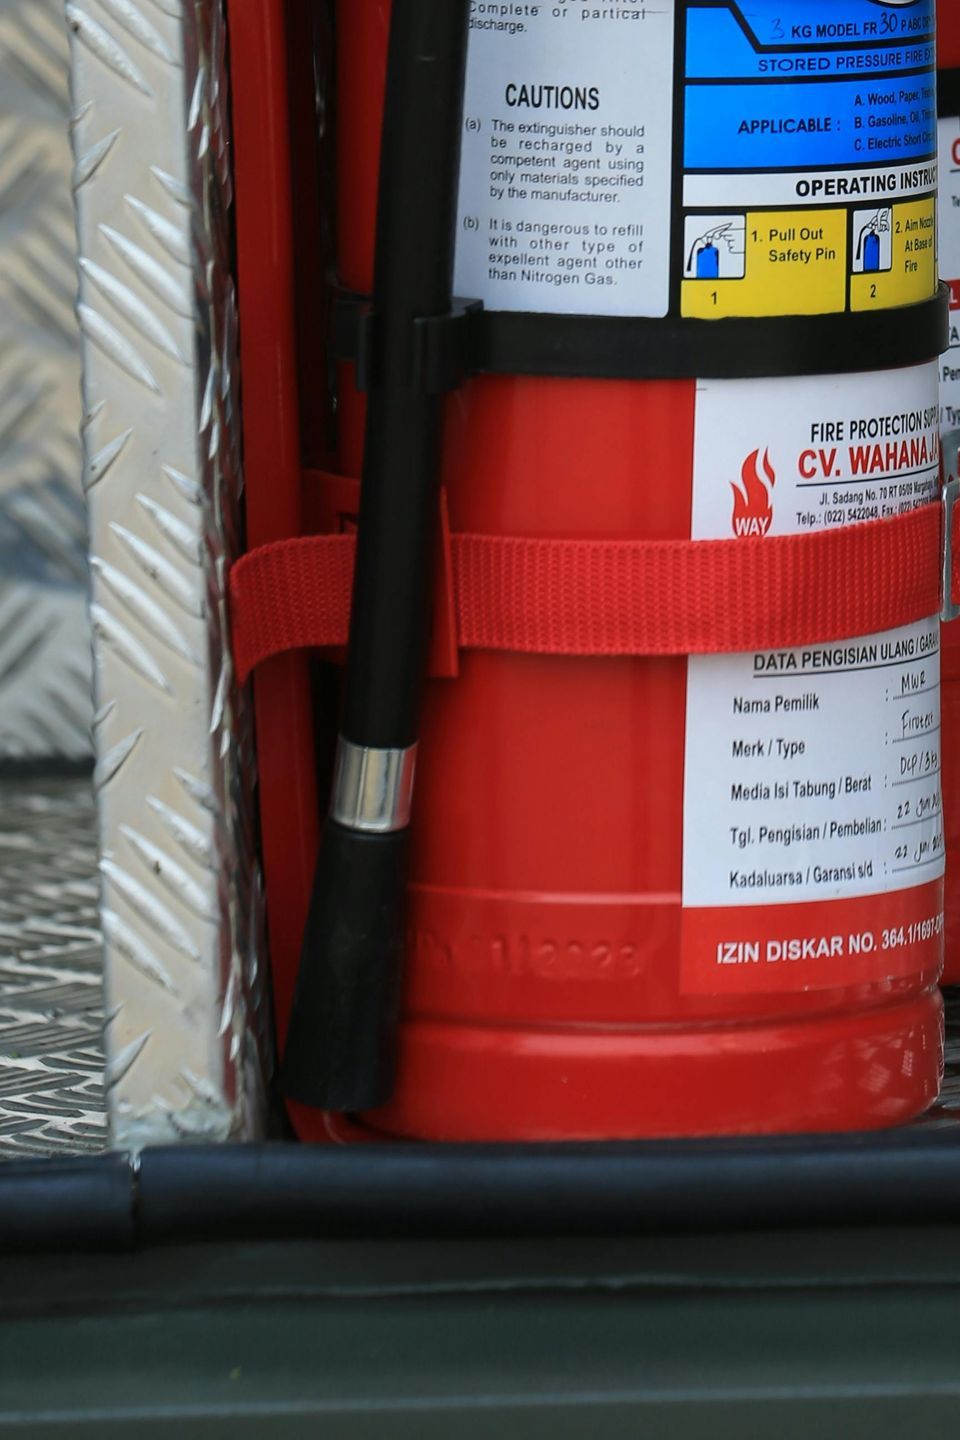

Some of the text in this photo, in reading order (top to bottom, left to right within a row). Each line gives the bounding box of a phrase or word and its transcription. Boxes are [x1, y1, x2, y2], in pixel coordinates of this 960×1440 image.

[552, 7, 568, 18] or
[581, 8, 646, 21] partical
[791, 24, 812, 39] KG
[815, 22, 860, 38] MODEL
[863, 21, 878, 35] FR
[758, 49, 923, 72] STORED PRESSURE FIRE
[505, 83, 600, 110] CAUTIONS
[854, 94, 866, 106] A.
[867, 92, 897, 106] Wood,
[465, 117, 645, 137] (a) The extinguisher should
[737, 117, 832, 134] APPLICABLE
[854, 116, 866, 129] B.
[867, 113, 909, 128] Gasoline,
[490, 136, 645, 156] be recharged by a
[854, 138, 866, 151] C.
[867, 136, 902, 150] Electric
[490, 154, 645, 173] competent agent using
[490, 170, 644, 188] only materials specified
[796, 173, 897, 198] OPERATING
[490, 185, 621, 203] by the manufacturer.
[462, 215, 644, 236] (b) It is dangerous to refill
[751, 227, 823, 243] 1. Pull Out
[895, 221, 903, 234] 2.
[904, 218, 919, 233] Aim
[488, 235, 645, 254] with other type of
[904, 240, 914, 253] At
[914, 236, 928, 252] Base
[488, 252, 643, 270] expellent agent other
[768, 246, 836, 263] Safety Pin
[904, 260, 918, 273] Fire
[488, 267, 618, 286] than Nitrogen Gas.
[710, 292, 718, 305] 1
[870, 284, 877, 298] 2
[811, 411, 923, 443] FIRE PROTECTION
[798, 435, 928, 479] CV. WAHANA
[819, 485, 898, 506] Jl. Sadang No. 70 RT
[735, 516, 769, 536] WAY
[823, 509, 846, 525] (022)
[753, 652, 798, 672] DATA
[801, 646, 877, 671] PENGISIAN
[880, 639, 914, 661] ULANG
[733, 695, 820, 714] Nama Pemilik
[732, 738, 806, 759] Merk Type
[730, 775, 872, 801] Media Isi Tabung Berat
[730, 818, 882, 849] Tgl. Pengisian Pembelian
[729, 860, 873, 888] Kadaluarsa Garansi s/d
[716, 932, 877, 964] IZIN DISKAR NO.
